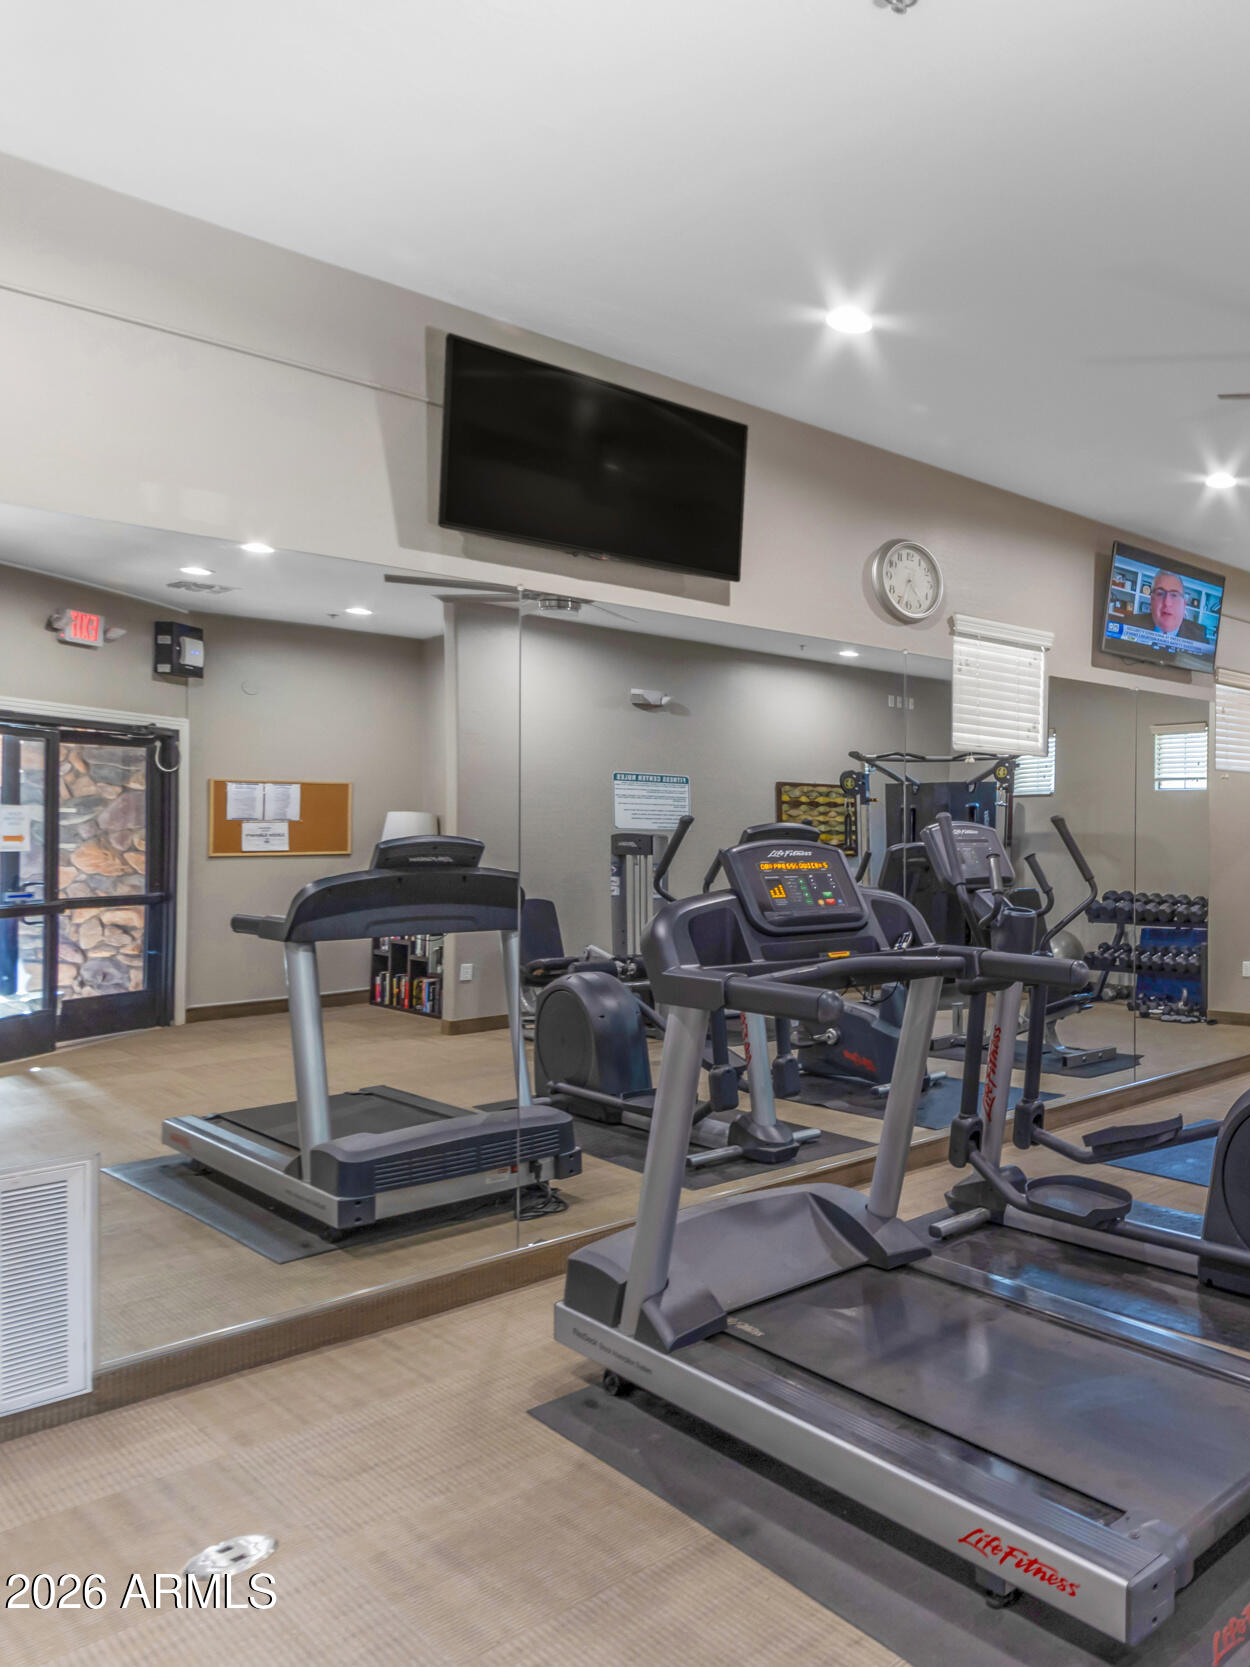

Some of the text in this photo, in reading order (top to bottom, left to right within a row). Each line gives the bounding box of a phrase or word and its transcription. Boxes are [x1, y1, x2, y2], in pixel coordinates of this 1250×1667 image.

[958, 1527, 1081, 1598] Life Fitness
[1212, 1616, 1247, 1667] Life
